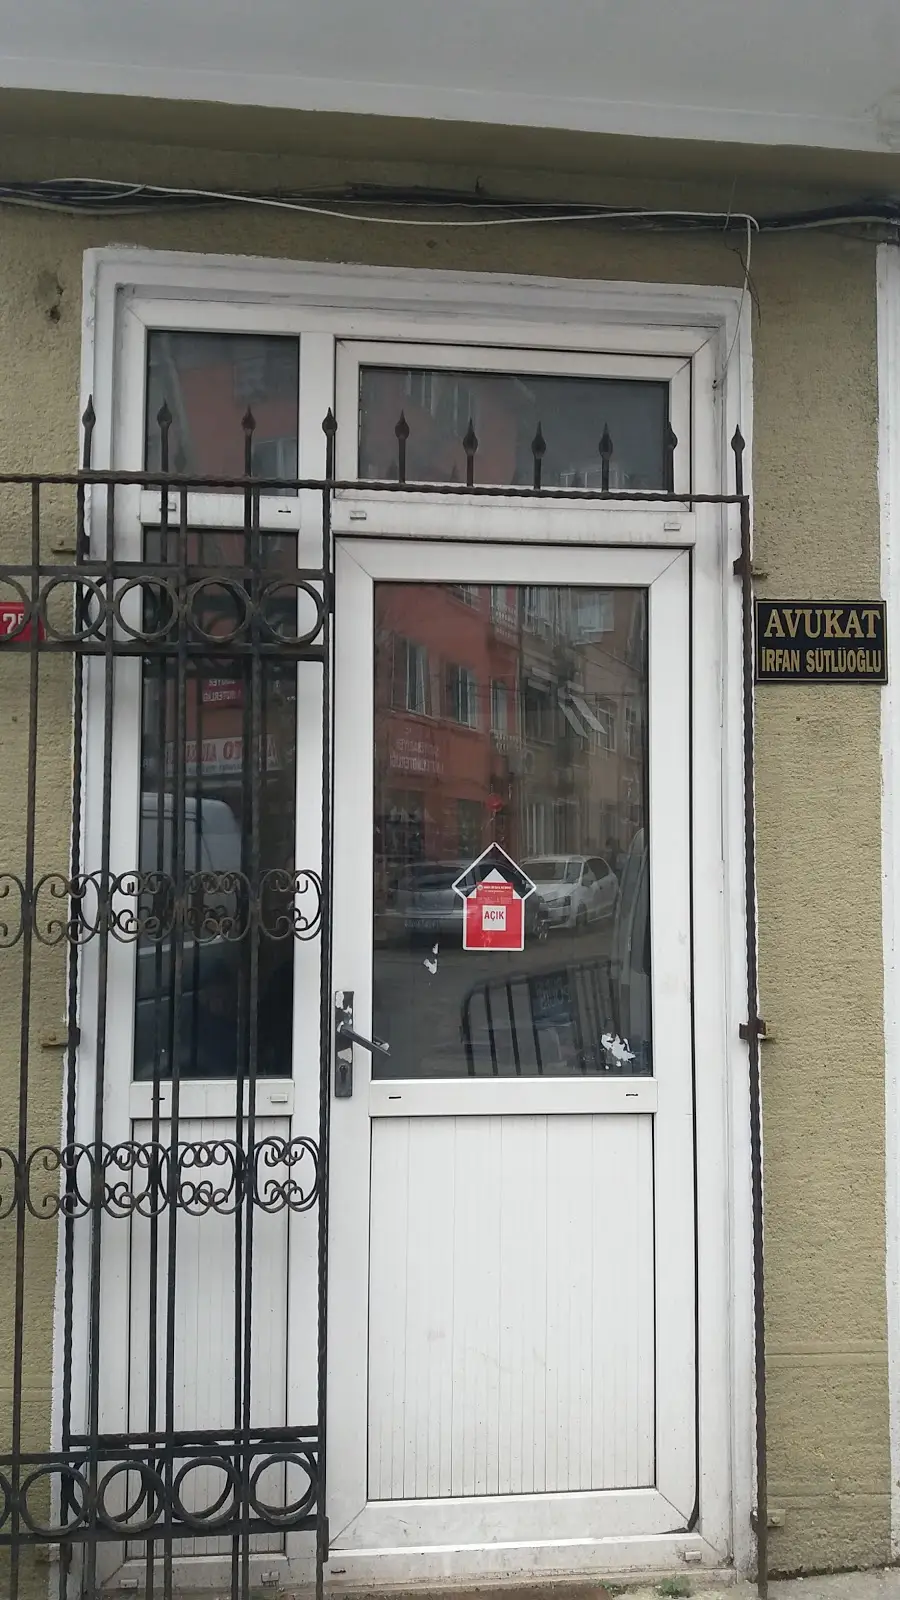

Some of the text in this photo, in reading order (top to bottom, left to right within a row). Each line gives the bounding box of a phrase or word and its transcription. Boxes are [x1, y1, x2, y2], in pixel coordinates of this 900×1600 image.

[764, 609, 881, 638] AVUKAT
[761, 646, 882, 673] İRFAN SÜTLÜOĞLU
[484, 910, 504, 921] AÇIK
